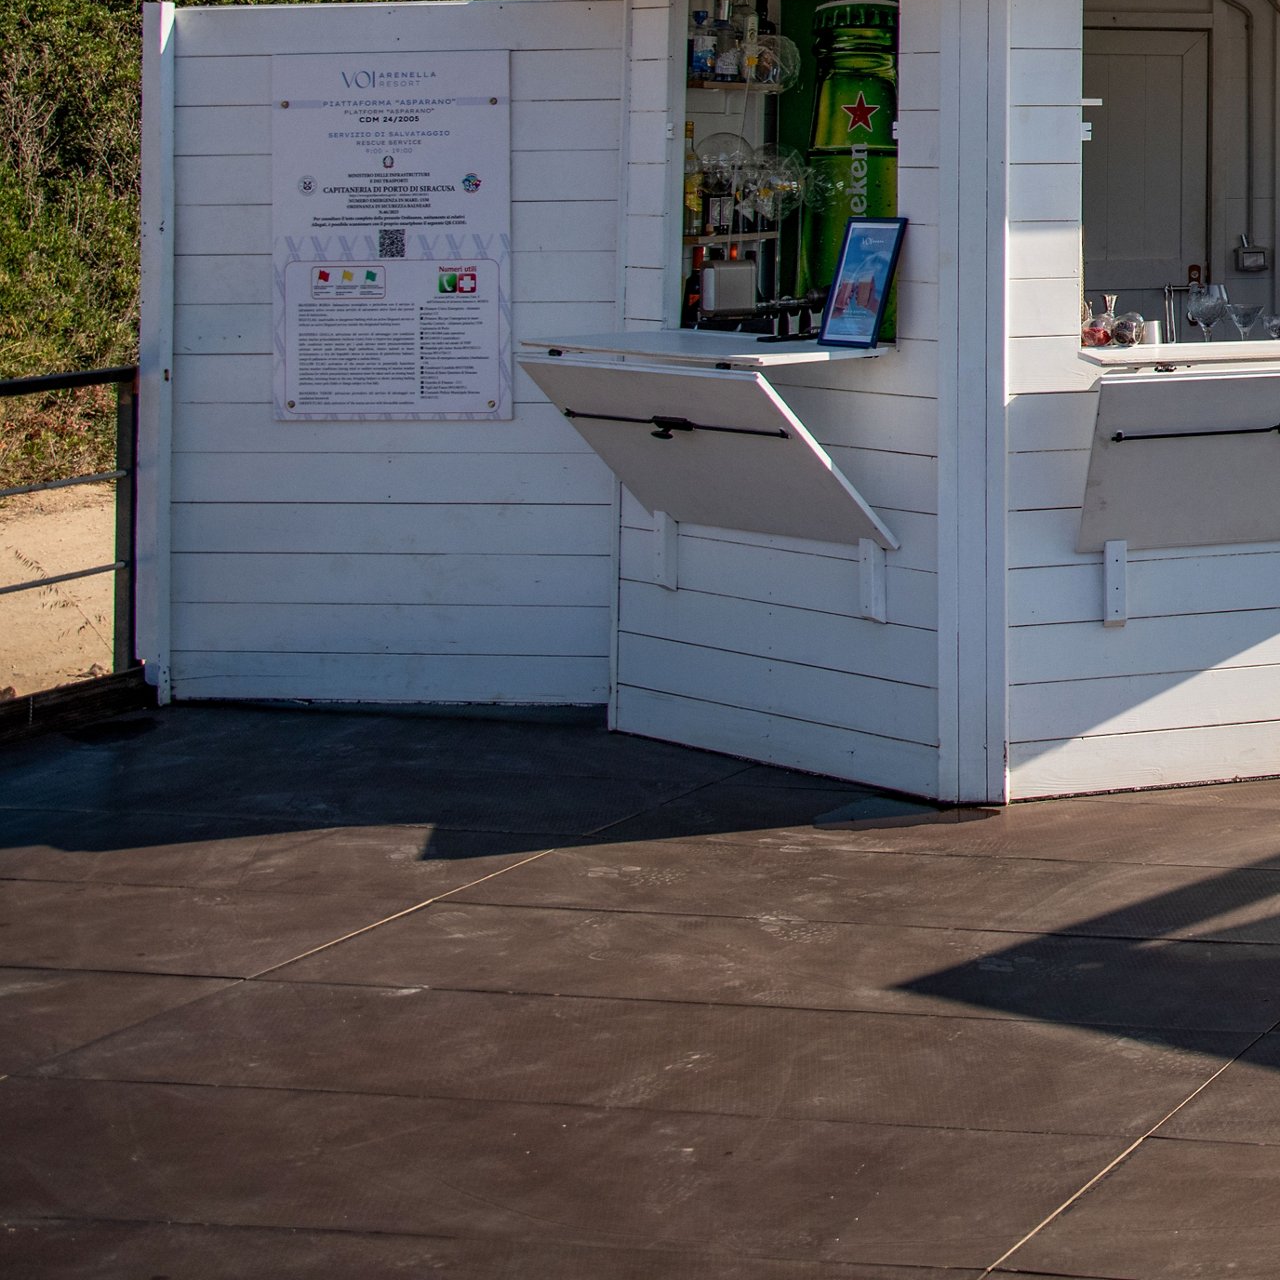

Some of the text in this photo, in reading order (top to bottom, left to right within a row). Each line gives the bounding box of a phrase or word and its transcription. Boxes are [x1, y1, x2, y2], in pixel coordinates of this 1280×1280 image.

[341, 70, 376, 89] VOI
[395, 98, 456, 106] "ASPARANO"
[383, 115, 420, 123] 24/2005
[846, 141, 868, 217] eken
[323, 186, 371, 194] CAPITANERIA
[383, 185, 408, 193] PORTO
[419, 184, 456, 192] SIRACUSA
